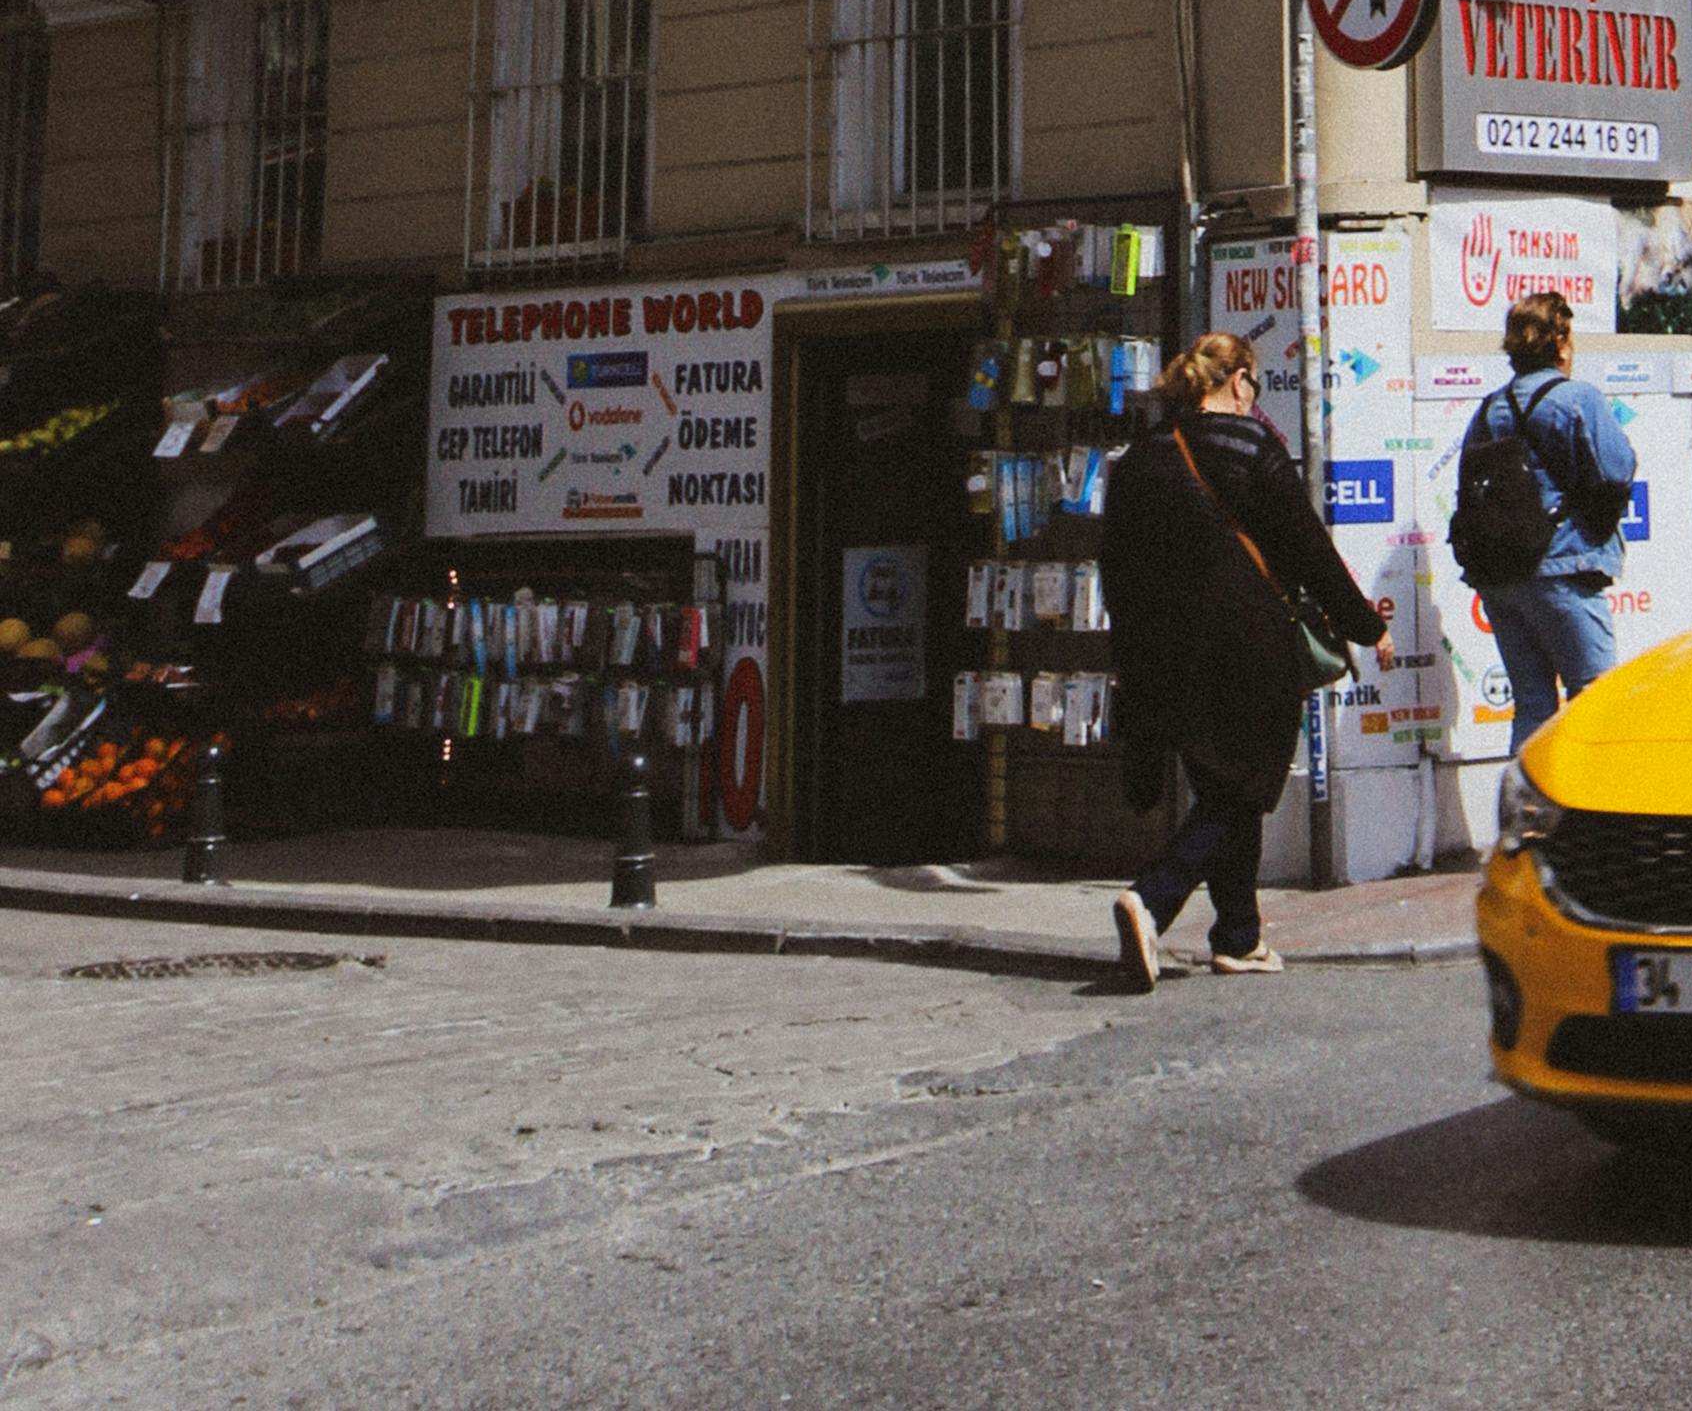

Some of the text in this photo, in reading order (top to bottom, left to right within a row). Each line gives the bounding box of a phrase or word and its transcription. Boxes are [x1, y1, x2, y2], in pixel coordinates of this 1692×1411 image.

[1487, 118, 1649, 155] 0212 244 16 91
[1226, 269, 1268, 313] NEW
[448, 289, 764, 346] TELEPHONE WORLD
[448, 361, 536, 409] GARANTİLİ
[675, 360, 763, 396] FATURA
[437, 423, 544, 462] CEP TELEFON
[678, 410, 757, 450] ÖDEME
[459, 468, 518, 516] TAMİRİ
[668, 472, 765, 507] NOKTASI
